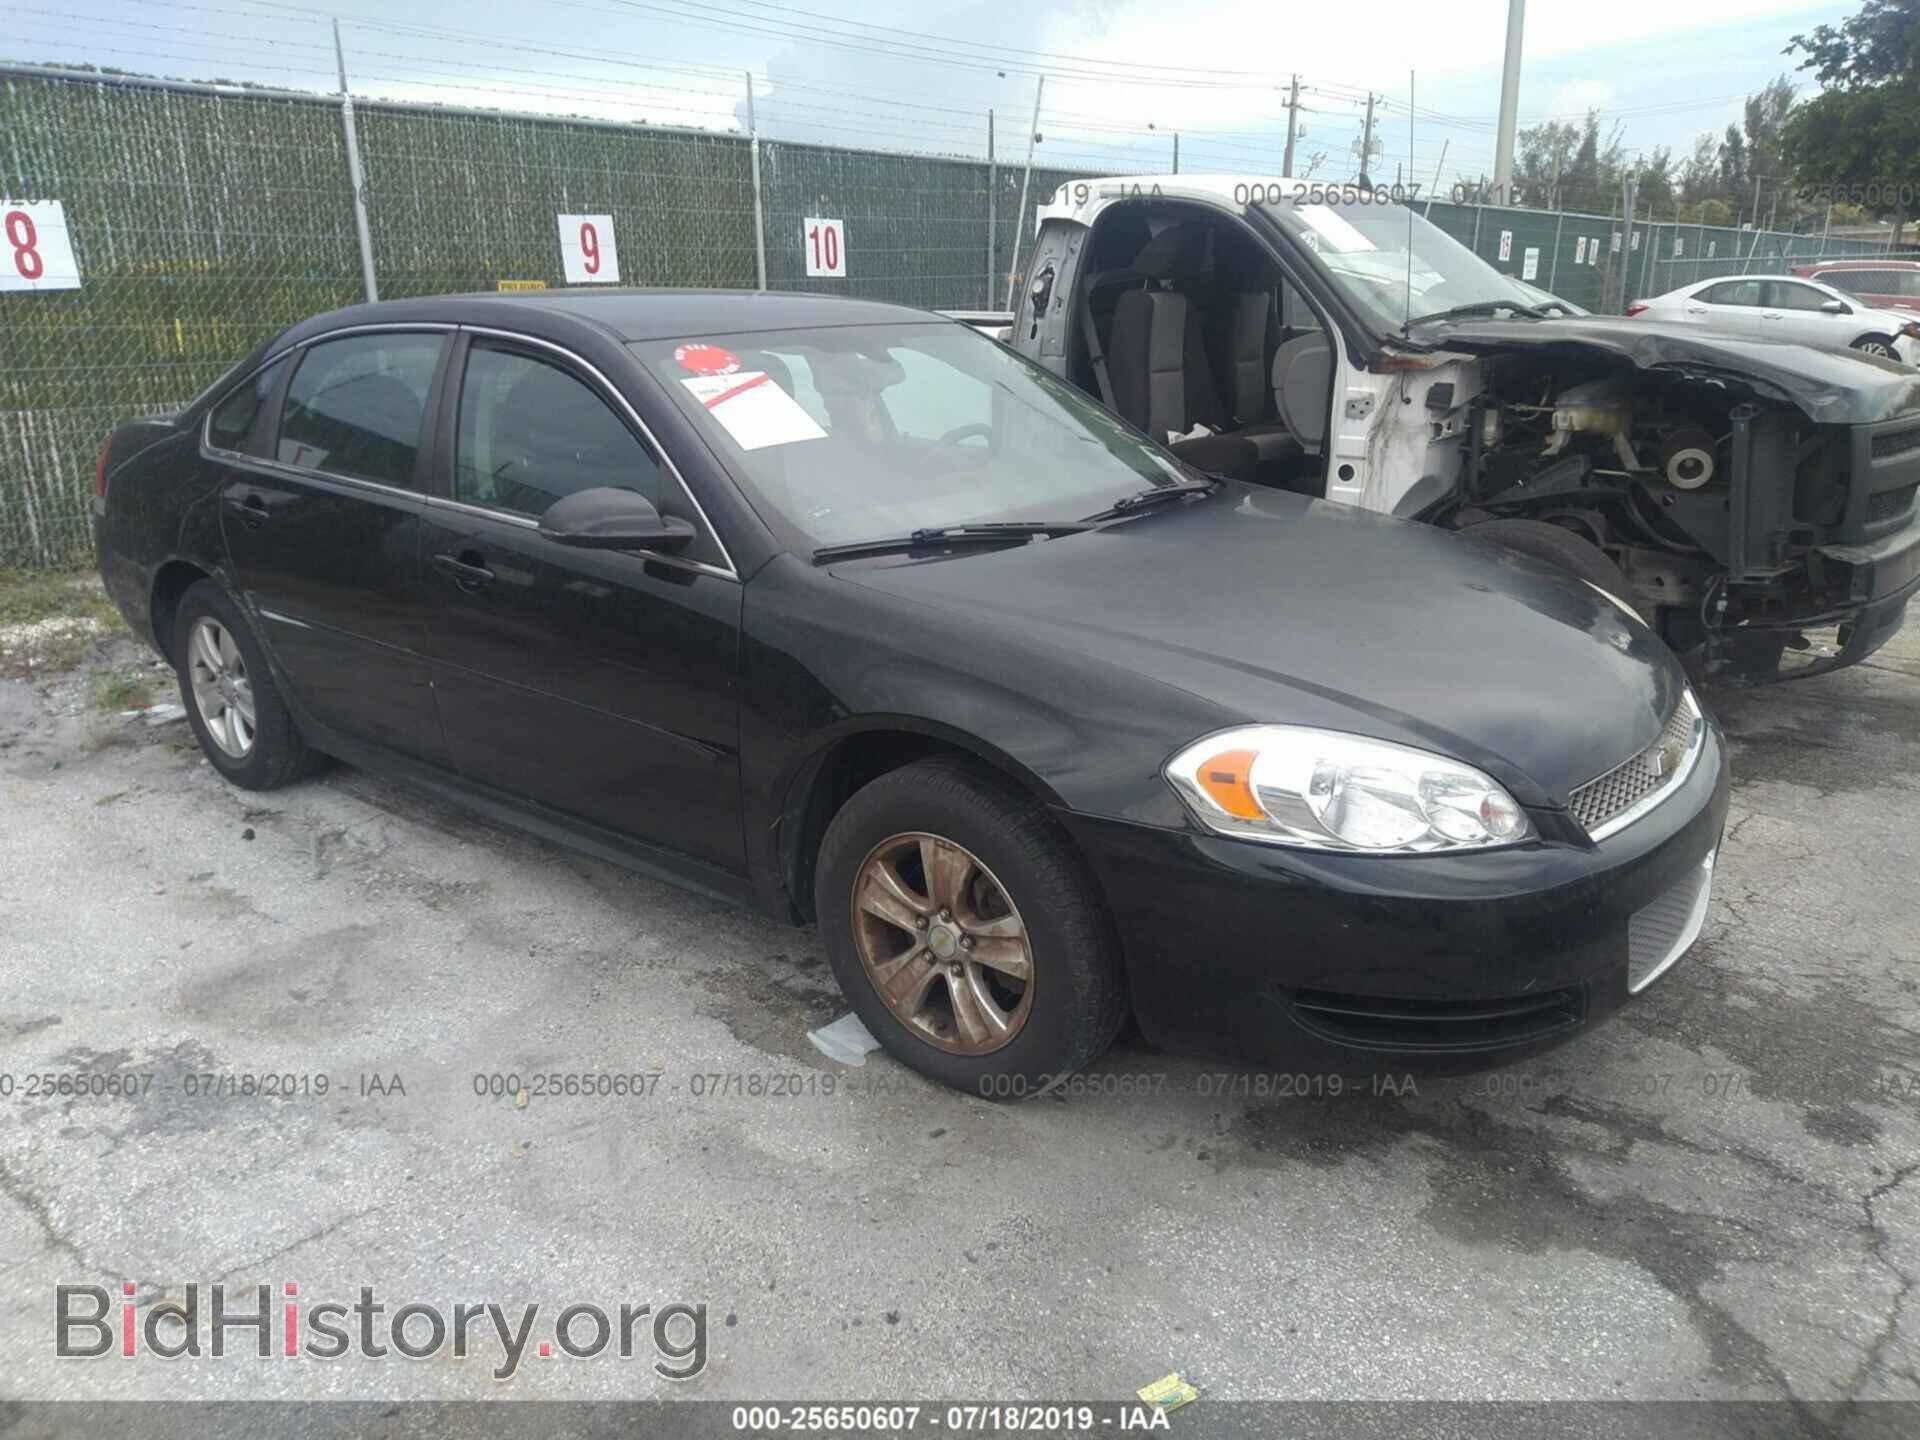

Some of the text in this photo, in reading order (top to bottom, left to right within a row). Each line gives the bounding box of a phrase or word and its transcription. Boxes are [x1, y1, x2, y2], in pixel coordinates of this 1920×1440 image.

[5, 211, 43, 280] 8
[580, 223, 600, 274] 9
[810, 225, 838, 270] 10
